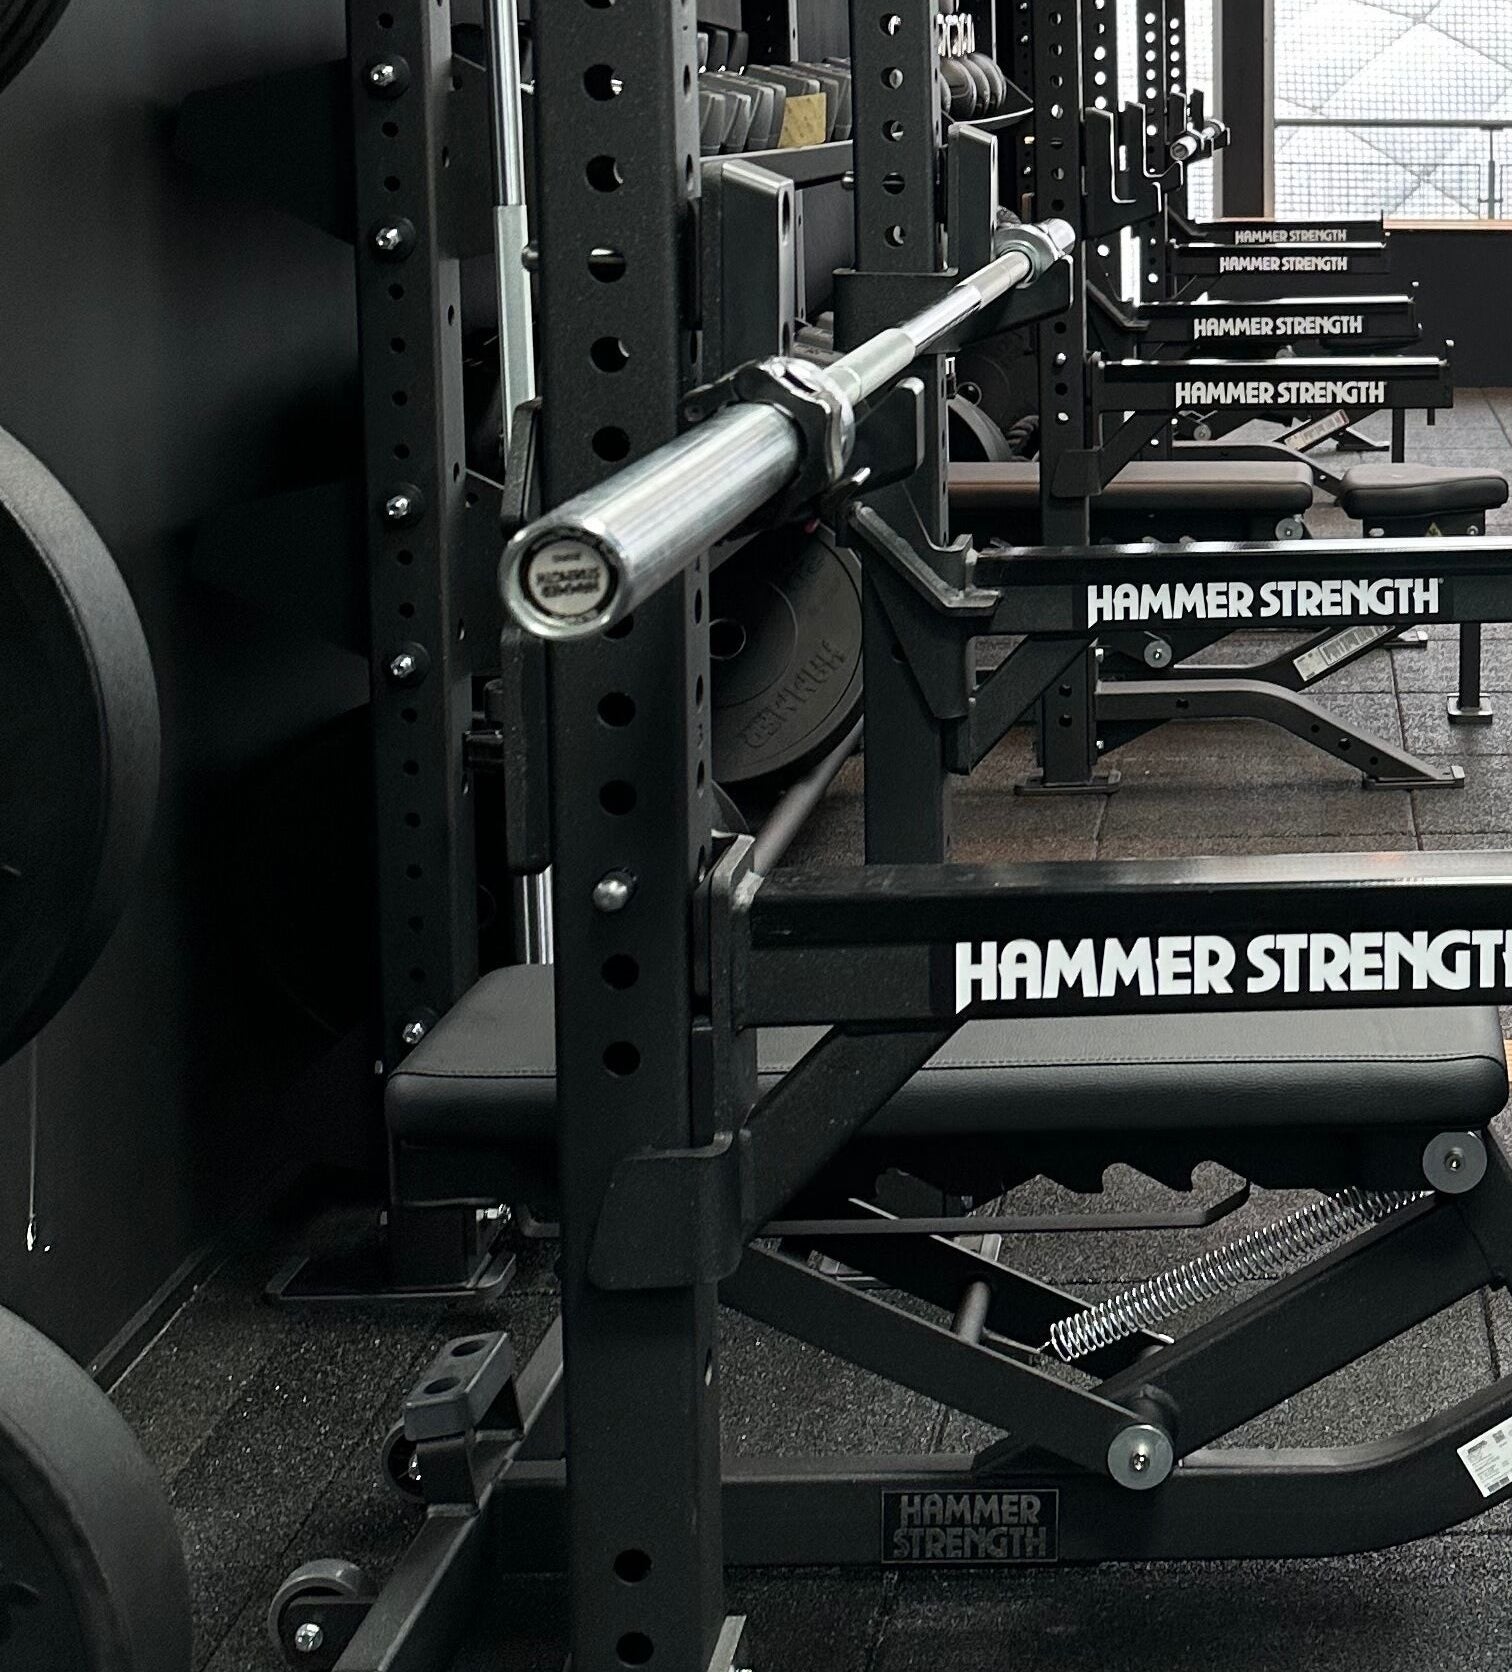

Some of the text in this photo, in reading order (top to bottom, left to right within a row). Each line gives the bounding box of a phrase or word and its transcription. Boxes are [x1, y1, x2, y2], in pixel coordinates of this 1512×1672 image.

[1235, 229, 1347, 244] HAMMER STRENGTH
[1220, 256, 1348, 273] HAMMER STRENGTH
[1194, 315, 1363, 339] HAMMER STRENGTH
[1175, 380, 1385, 408] HAMMER STRENGTH
[1087, 581, 1254, 629] HAMMER
[955, 934, 1236, 1014] HAMMER
[900, 1493, 1041, 1527] HAMMER
[893, 1527, 1047, 1559] STRENGTH
